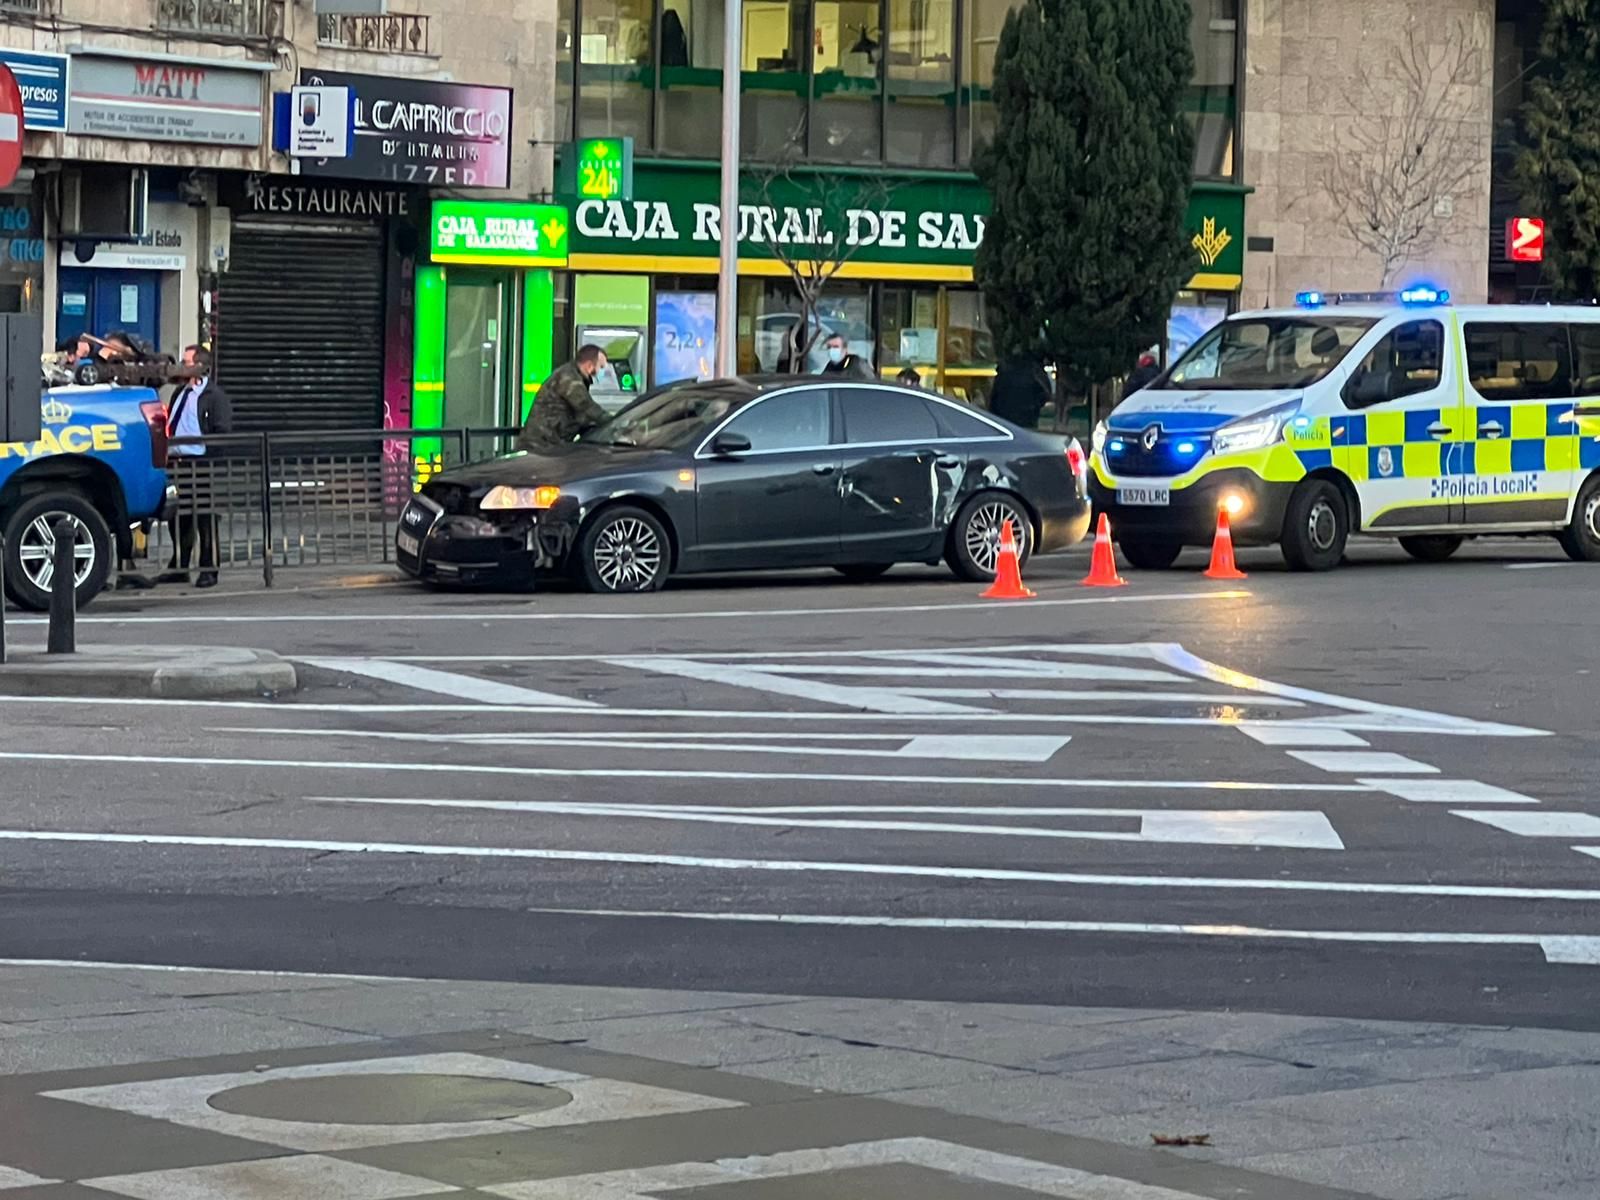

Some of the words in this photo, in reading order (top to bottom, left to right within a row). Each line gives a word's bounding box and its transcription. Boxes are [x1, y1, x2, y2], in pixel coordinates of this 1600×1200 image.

[132, 64, 205, 101] MATT
[107, 112, 115, 121] DE
[118, 113, 155, 124] ACCIDENTES
[157, 115, 165, 124] DE
[168, 116, 194, 127] TRABAJO
[372, 100, 504, 137] CAPRICCIO
[582, 167, 618, 199] 24h
[253, 186, 408, 215] RESTAURANTE
[0, 207, 30, 230] RO
[438, 215, 478, 235] CAJA
[484, 217, 539, 238] RURAL
[575, 199, 679, 242] CAJA
[846, 208, 906, 247] DE
[155, 229, 182, 247] Estado
[438, 234, 455, 247] DE
[1148, 488, 1167, 502] LRC
[1441, 477, 1488, 497] Policía
[1493, 475, 1529, 494] Local
